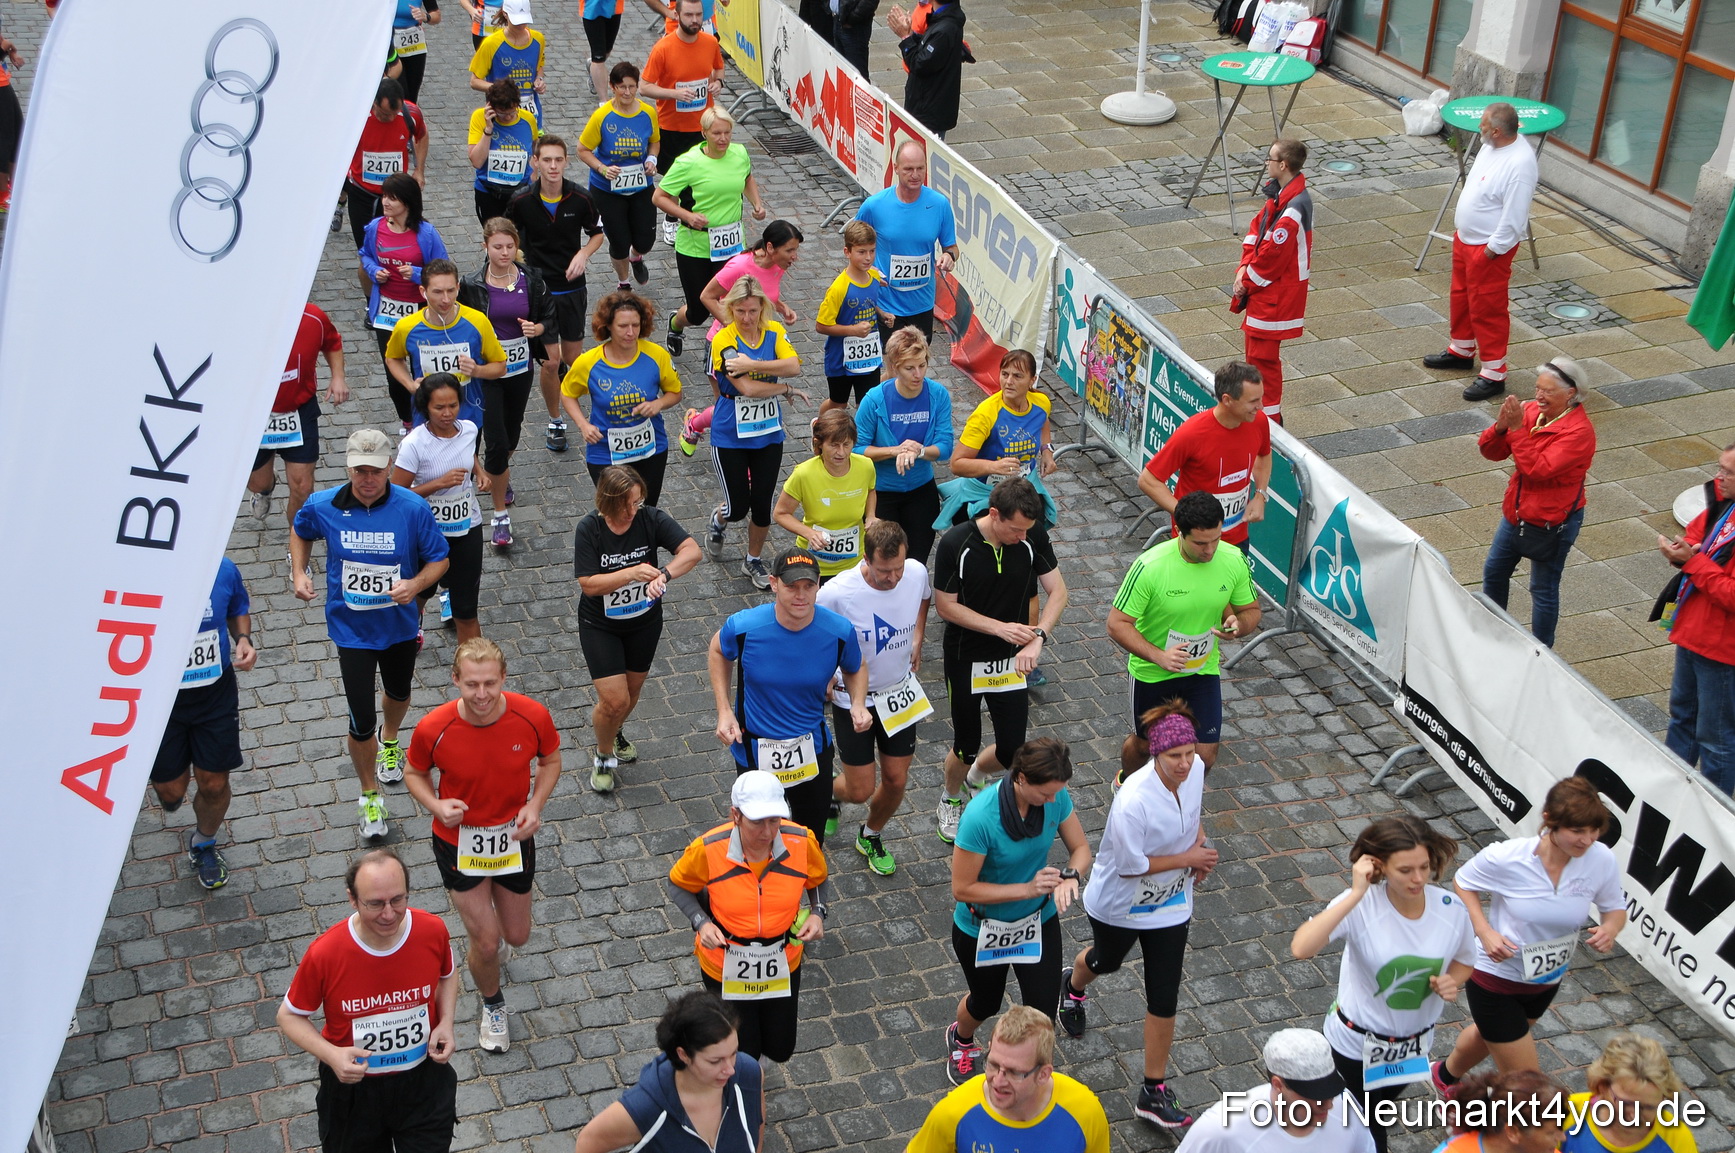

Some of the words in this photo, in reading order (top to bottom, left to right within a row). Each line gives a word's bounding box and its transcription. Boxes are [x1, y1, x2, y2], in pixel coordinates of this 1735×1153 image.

[400, 33, 420, 47] 243
[366, 159, 400, 174] 2470
[492, 159, 525, 175] 2471
[614, 172, 644, 188] 2776
[713, 230, 741, 249] 2601
[907, 257, 927, 266] Neumarkt
[894, 262, 928, 279] 2210
[380, 299, 415, 318] 2249
[858, 336, 877, 345] Neumarkt
[420, 348, 437, 356] PARTL
[437, 347, 462, 356] Neumarkt
[848, 341, 880, 361] 3334
[430, 355, 461, 373] 164
[740, 401, 776, 421] 2710
[1151, 401, 1185, 436] Meh
[264, 414, 298, 434] 455
[116, 341, 213, 550] BKK
[267, 436, 289, 444] Günter
[613, 430, 651, 452] 2629
[430, 500, 469, 523] 2908
[340, 530, 395, 544] HUBER
[352, 543, 394, 551] TECHNOLOGY
[344, 564, 362, 573] PARTL
[347, 573, 393, 594] 2851
[352, 596, 388, 606] Christian
[883, 638, 909, 652] Team
[1168, 633, 1188, 644] PARTL
[1331, 616, 1356, 642] Service
[1356, 635, 1378, 659] GmbH
[182, 669, 212, 682] ernhard
[983, 660, 1011, 676] 307
[60, 589, 164, 816] Audi
[886, 685, 917, 714] 636
[771, 745, 805, 771] 321
[779, 770, 806, 783] Andreas
[1450, 741, 1467, 762] die
[1467, 755, 1517, 812] verbinden
[485, 823, 510, 834] Neumarkt
[472, 832, 508, 855] 318
[468, 857, 511, 868] Alexander
[984, 924, 1036, 949] 2626
[748, 950, 779, 959] Neumarkt
[1523, 944, 1548, 954] PARTL
[737, 958, 778, 979] 216
[1531, 948, 1571, 977] 253
[744, 982, 769, 993] Helga
[341, 987, 420, 1012] NEUMARKT
[355, 1022, 381, 1031] PARTL
[382, 1014, 418, 1027] Neumarkt
[362, 1021, 425, 1053] 2553
[380, 1053, 409, 1066] Frank
